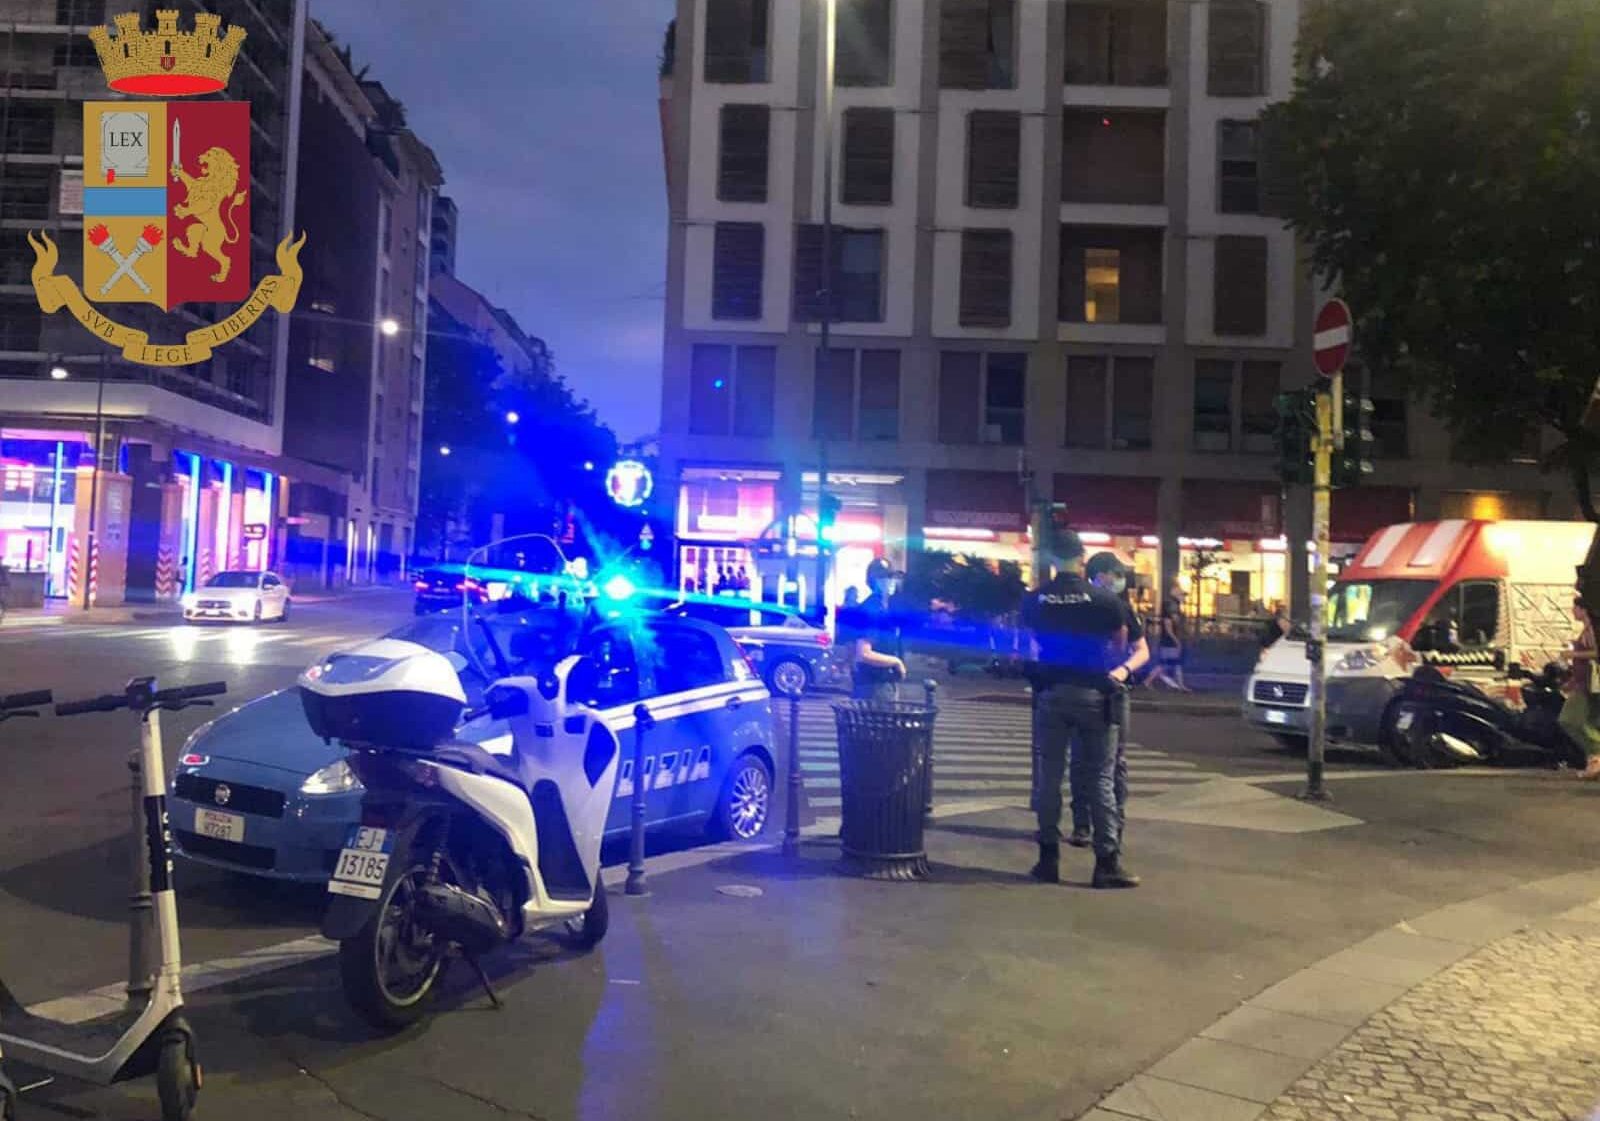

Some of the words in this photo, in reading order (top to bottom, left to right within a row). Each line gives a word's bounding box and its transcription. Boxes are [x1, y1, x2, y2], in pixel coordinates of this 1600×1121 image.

[1037, 592, 1092, 605] POLIZIA
[355, 828, 378, 850] EJ
[339, 853, 388, 881] 13185
